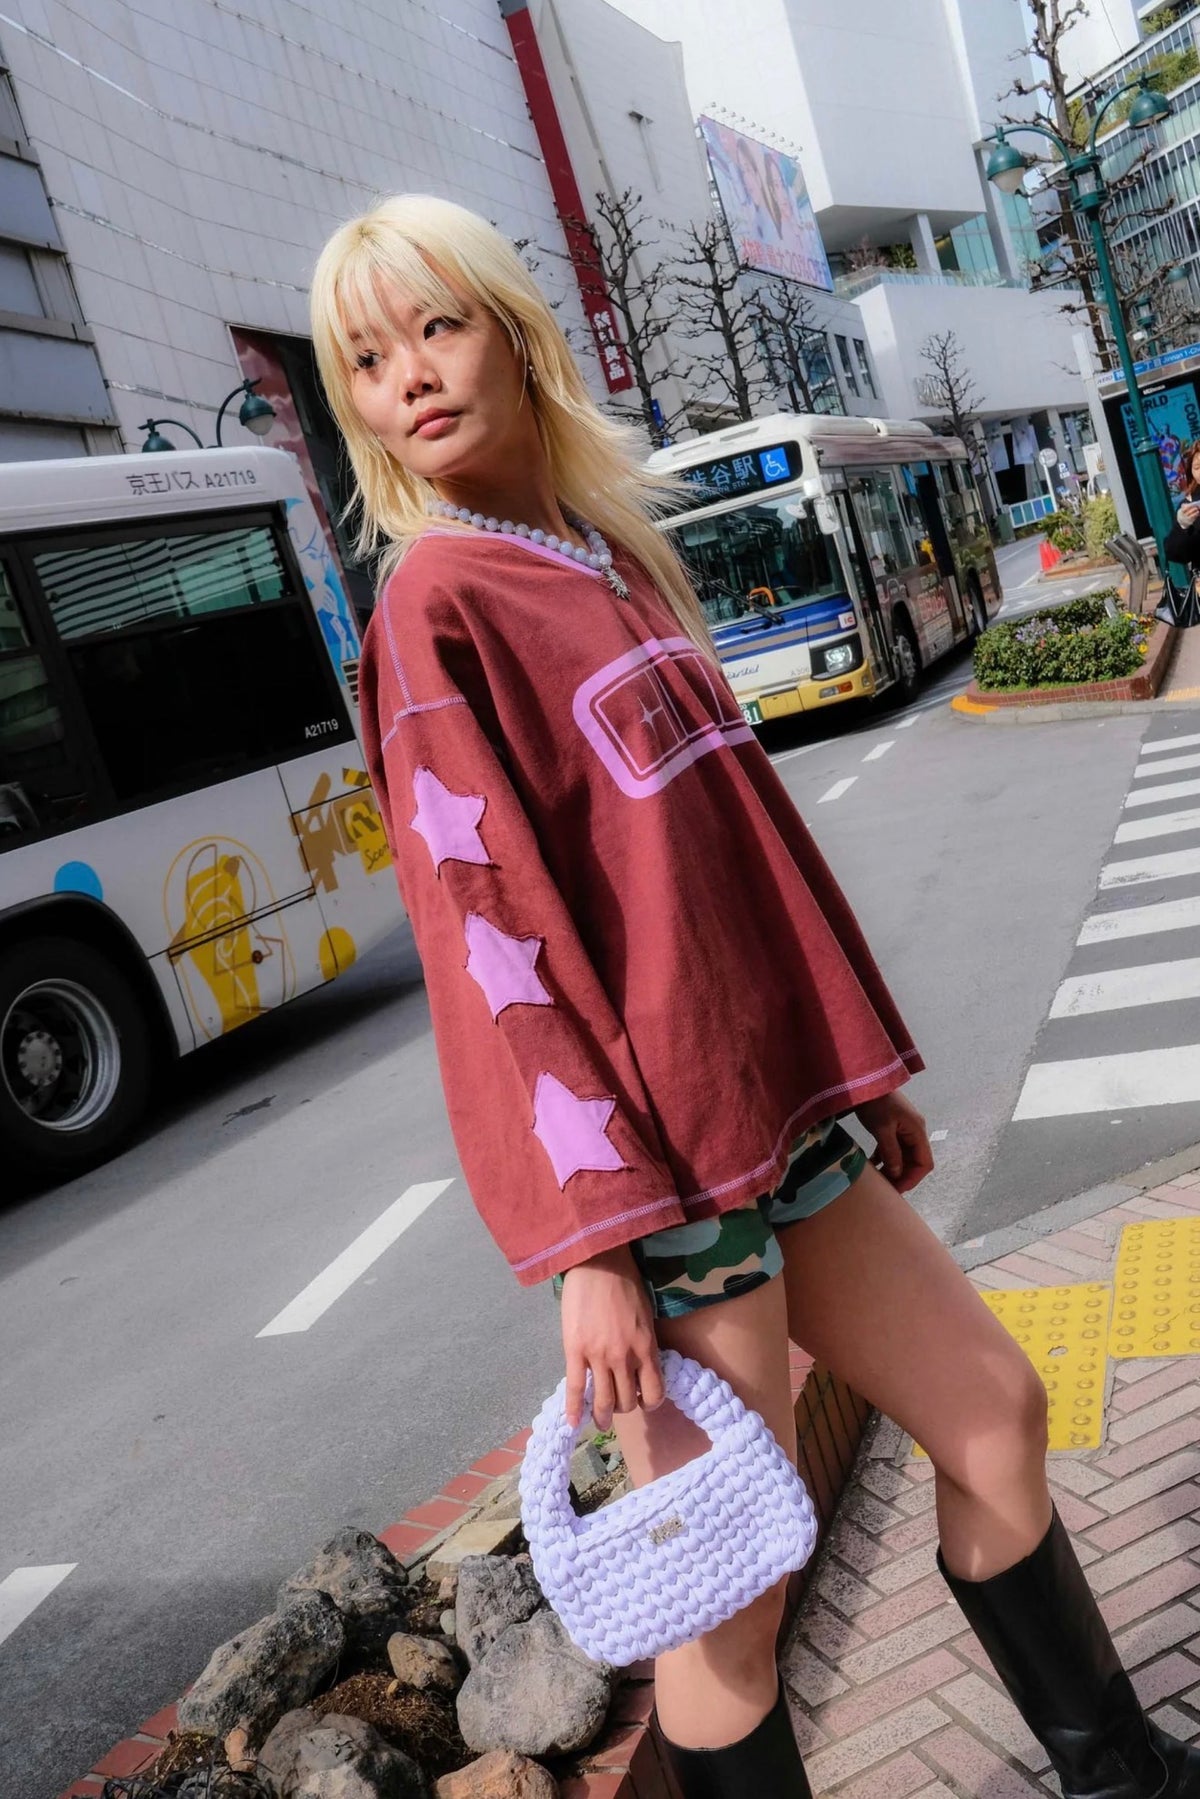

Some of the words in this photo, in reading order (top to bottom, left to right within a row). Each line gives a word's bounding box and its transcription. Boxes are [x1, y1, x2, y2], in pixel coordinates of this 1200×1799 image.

[1123, 394, 1169, 416] WRLD
[126, 471, 200, 496] 京王バス
[204, 469, 257, 489] A21719
[304, 718, 339, 739] A21719
